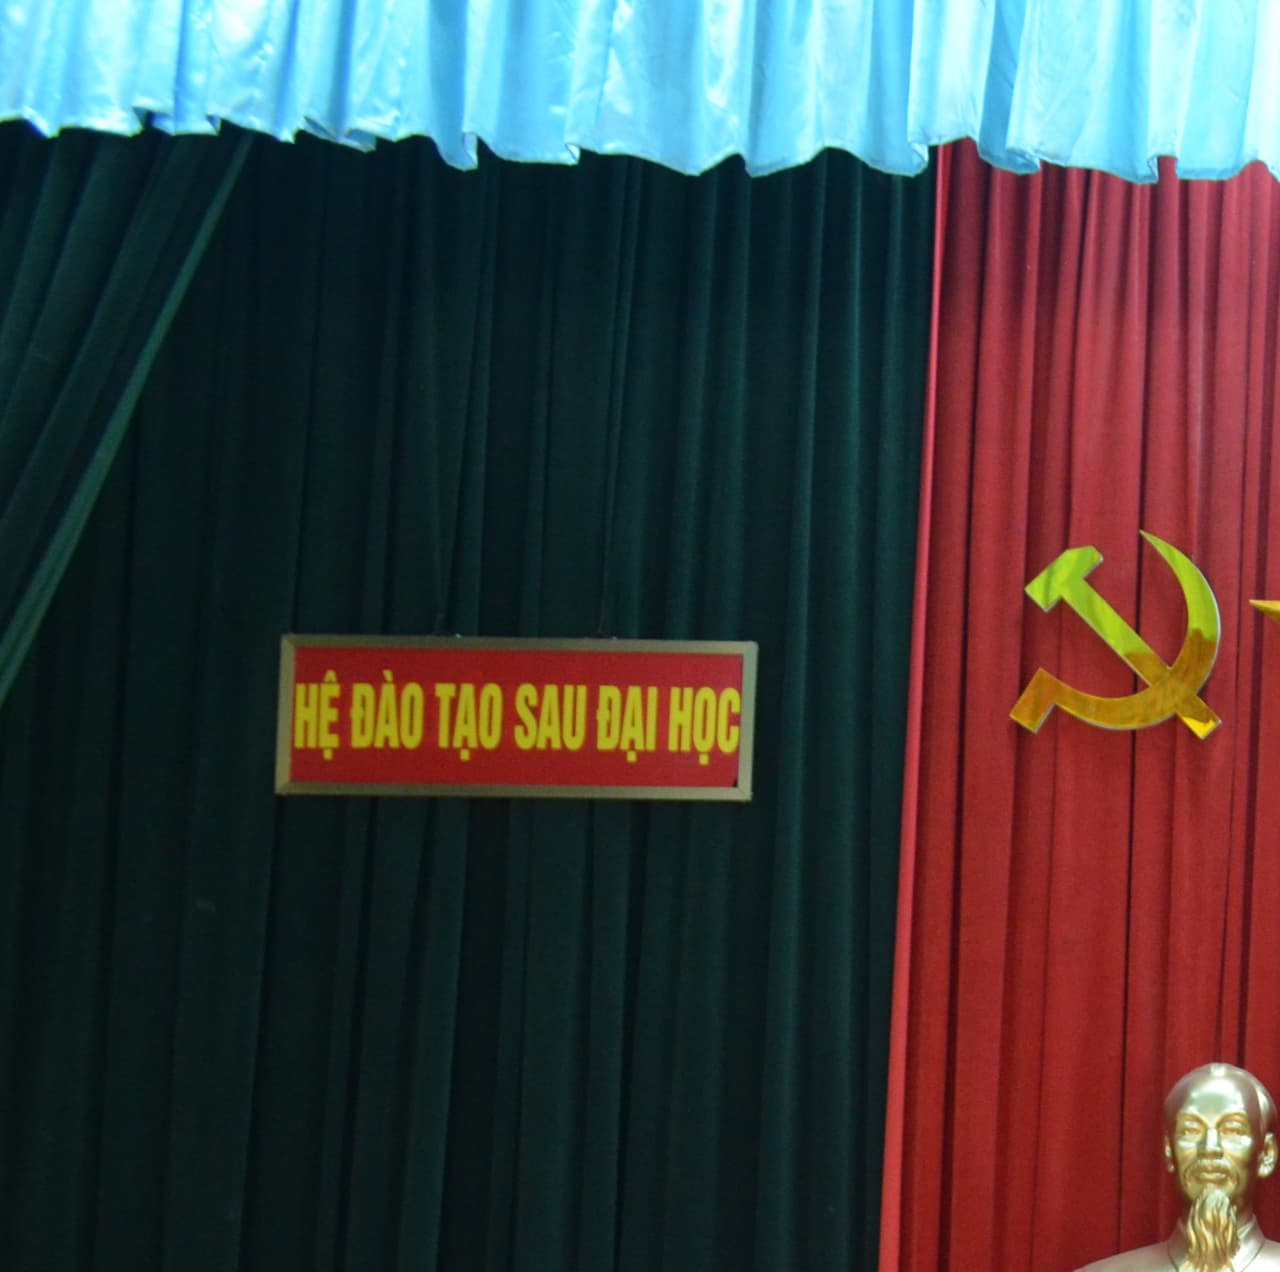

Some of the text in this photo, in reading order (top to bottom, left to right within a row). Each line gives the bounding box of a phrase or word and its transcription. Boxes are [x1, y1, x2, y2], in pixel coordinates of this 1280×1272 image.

[295, 670, 741, 764] HỆ ĐÀO TẠO SAU ĐẠI HỌC
